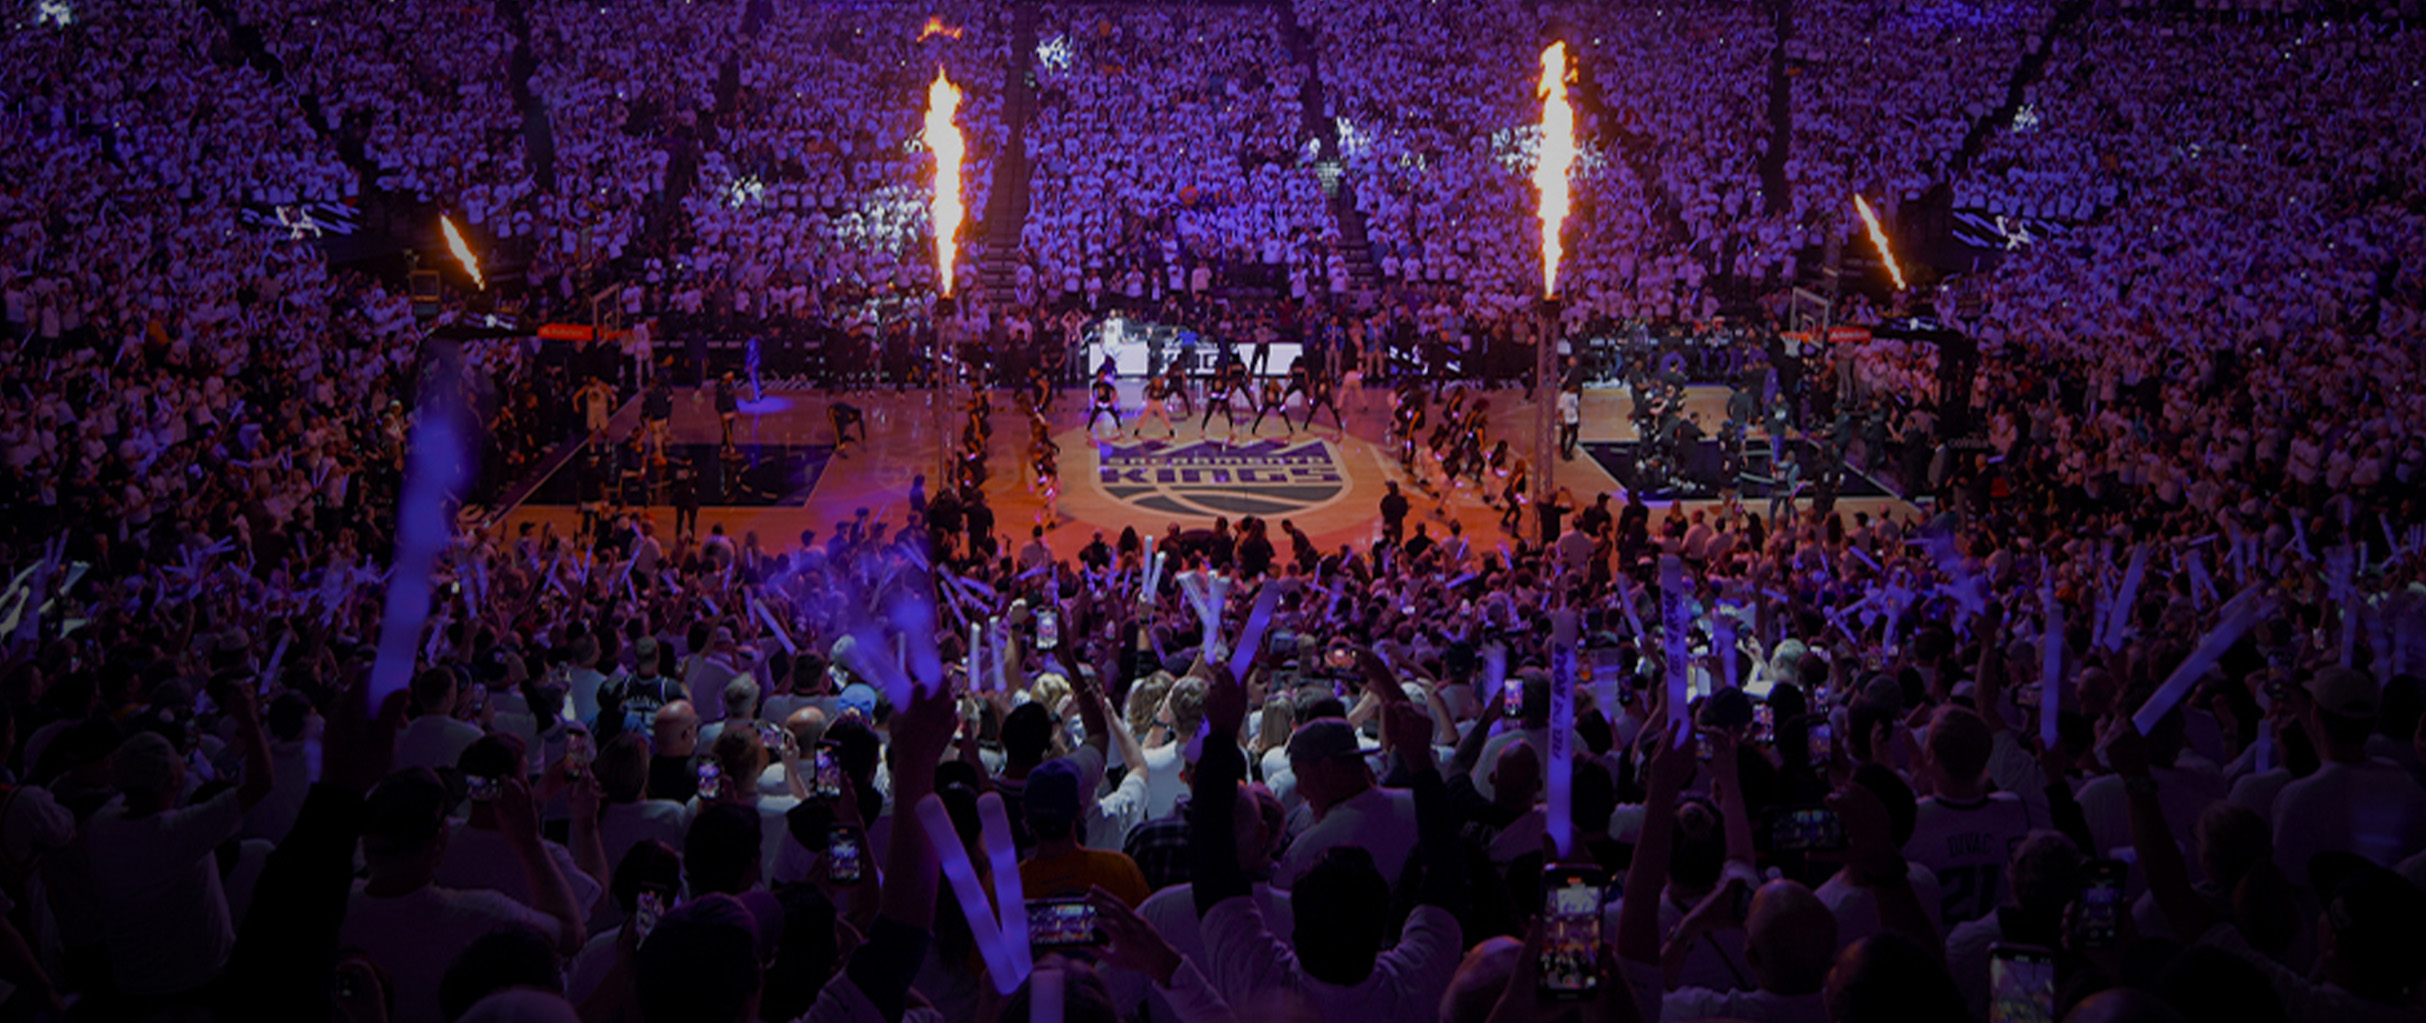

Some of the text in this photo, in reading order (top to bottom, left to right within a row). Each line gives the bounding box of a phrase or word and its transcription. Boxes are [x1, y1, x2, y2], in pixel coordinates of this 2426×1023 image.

[1100, 467, 1342, 482] KINGS
[1553, 645, 1567, 698] ROAR
[1552, 727, 1562, 760] FEEL
[1947, 832, 1993, 857] DIVAC
[1938, 864, 2000, 924] 21
